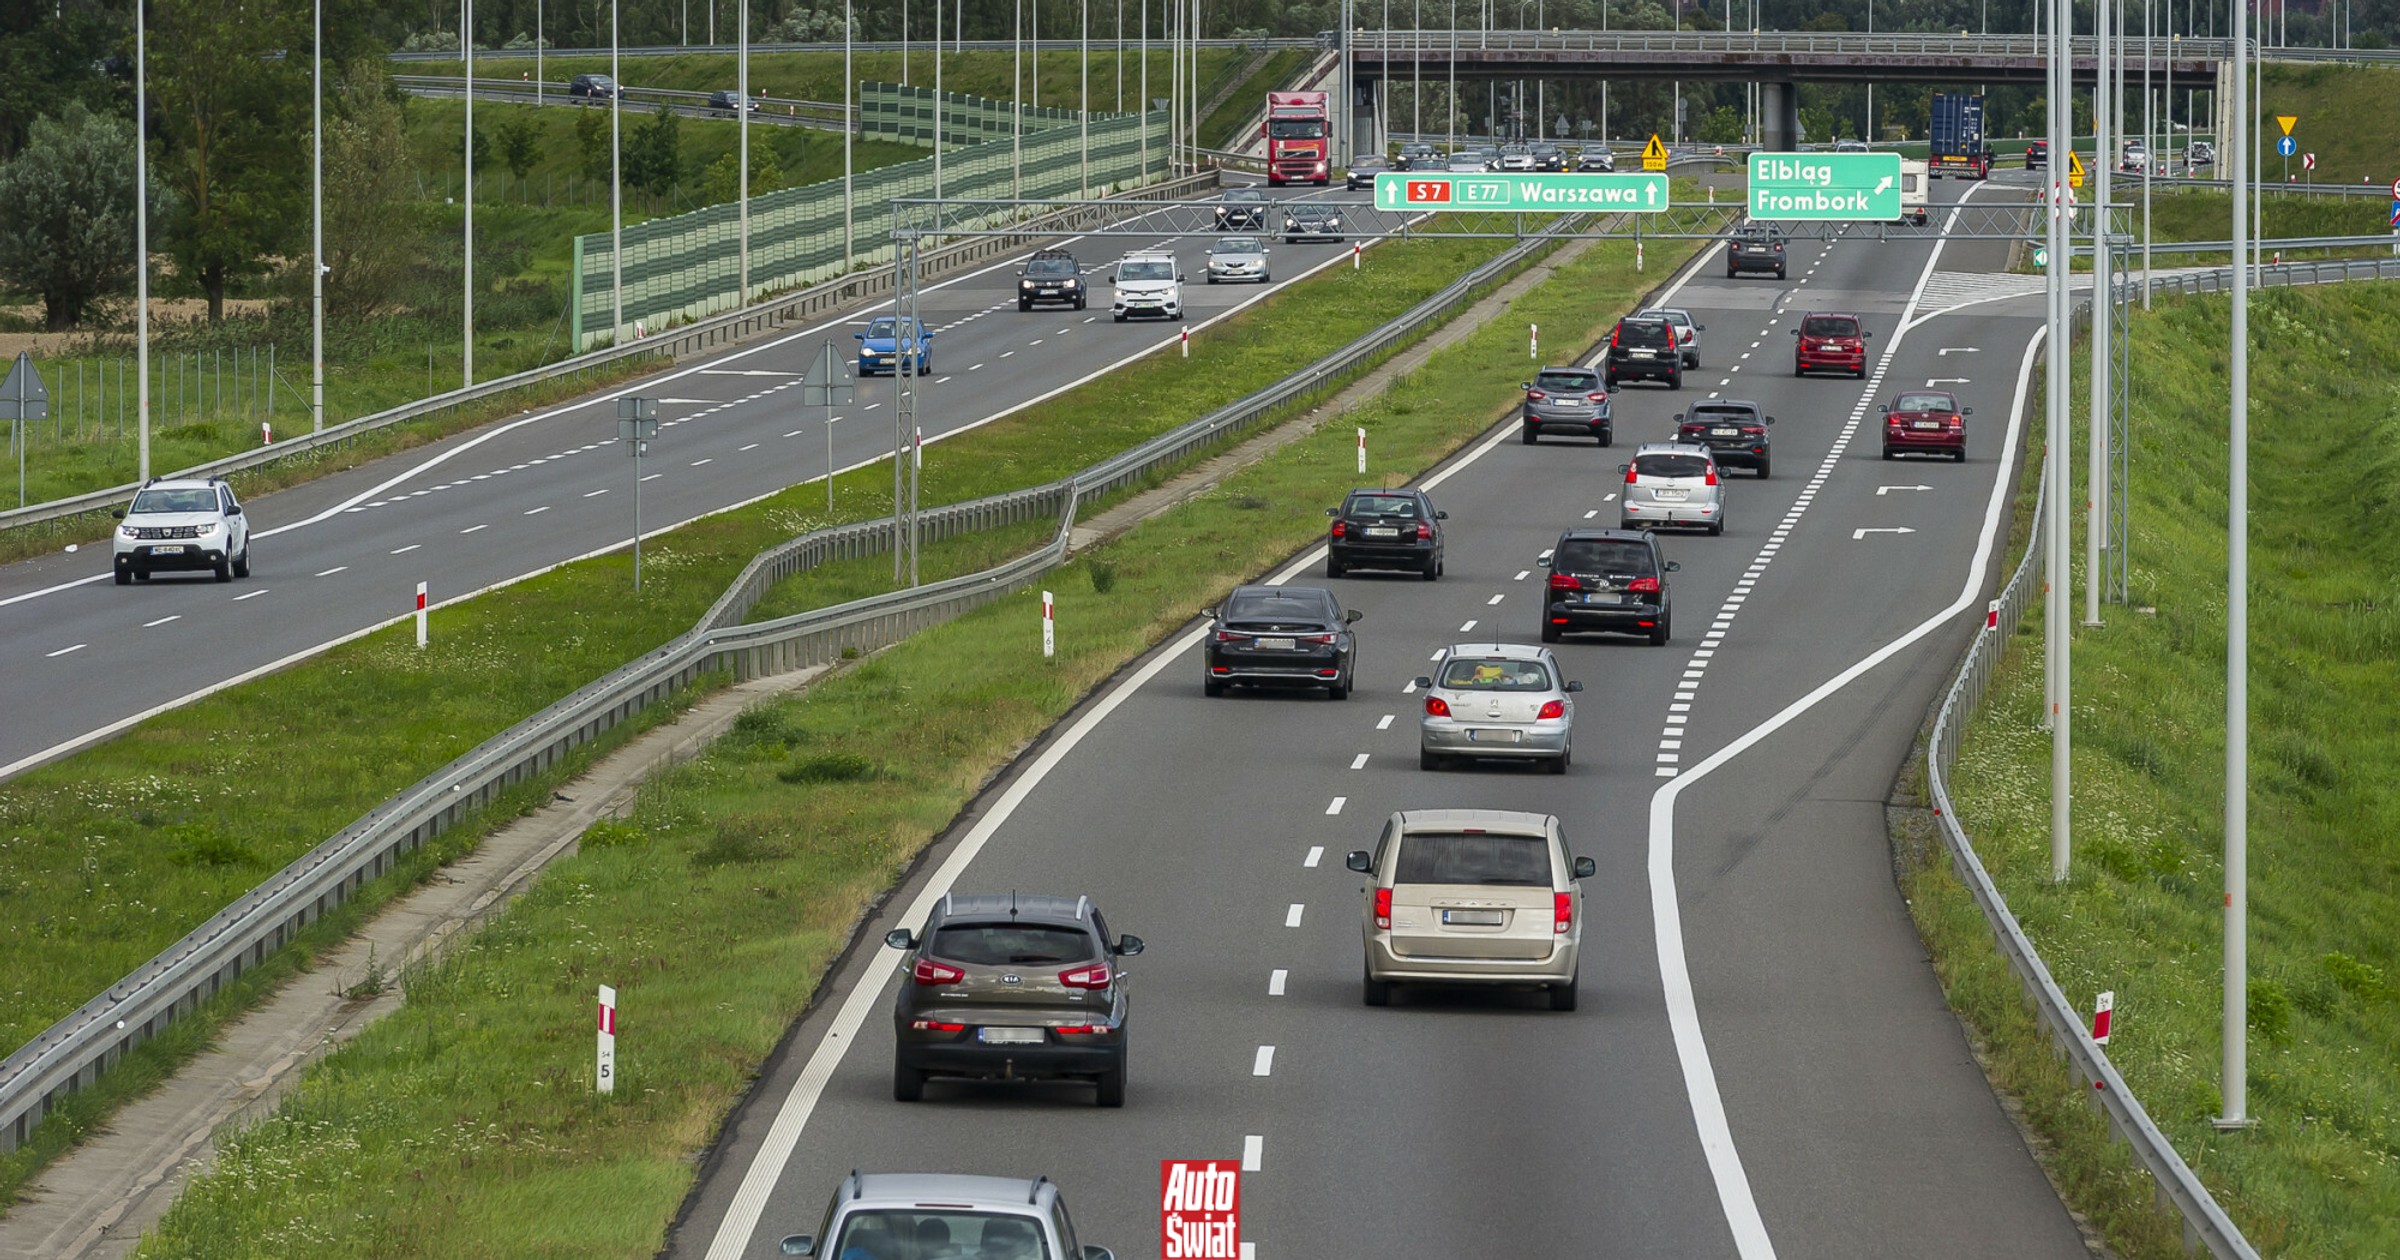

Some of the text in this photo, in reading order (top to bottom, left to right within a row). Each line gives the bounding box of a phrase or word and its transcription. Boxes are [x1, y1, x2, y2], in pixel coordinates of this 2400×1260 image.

[1757, 159, 1832, 186] Elbląg
[1520, 182, 1638, 203] Warszawa
[1757, 189, 1870, 211] Frombork
[1002, 975, 1019, 983] KIA
[601, 1064, 610, 1078] 5
